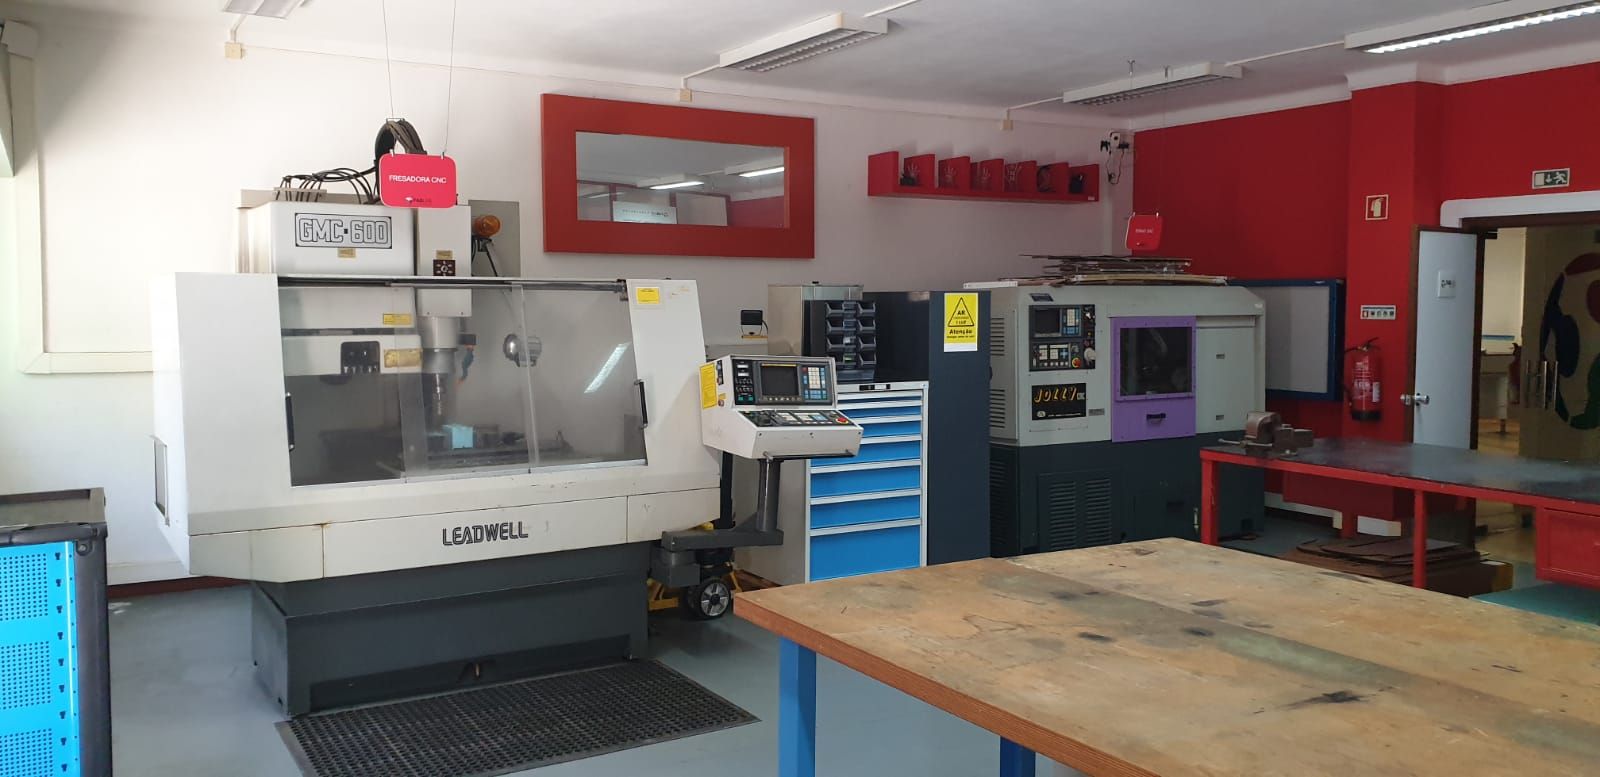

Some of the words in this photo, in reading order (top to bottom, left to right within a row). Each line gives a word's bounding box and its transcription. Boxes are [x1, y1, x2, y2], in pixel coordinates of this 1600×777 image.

[389, 174, 430, 183] FRESADORA
[1034, 387, 1077, 403] JOLLY
[442, 521, 529, 546] LEADWELL
